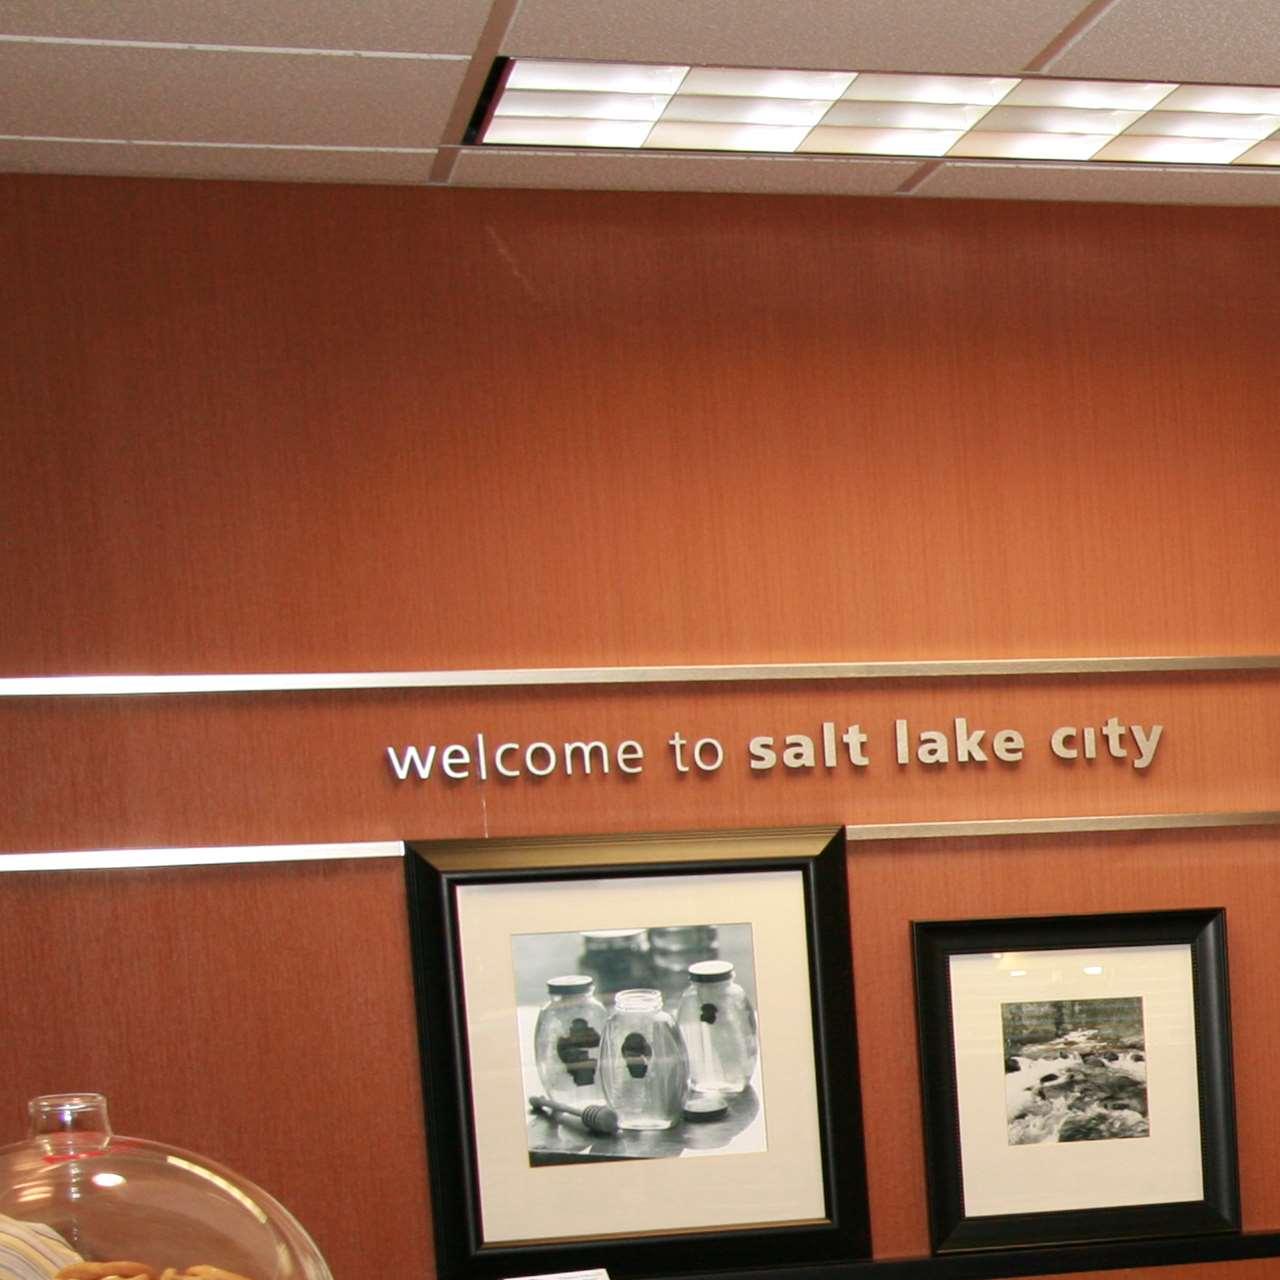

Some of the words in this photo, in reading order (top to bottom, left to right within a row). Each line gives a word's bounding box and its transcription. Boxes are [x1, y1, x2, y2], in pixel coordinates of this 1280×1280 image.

[387, 733, 644, 780] welcome
[668, 731, 724, 772] to
[748, 721, 870, 769] salt
[895, 717, 1025, 765] lake
[1050, 717, 1163, 768] city
